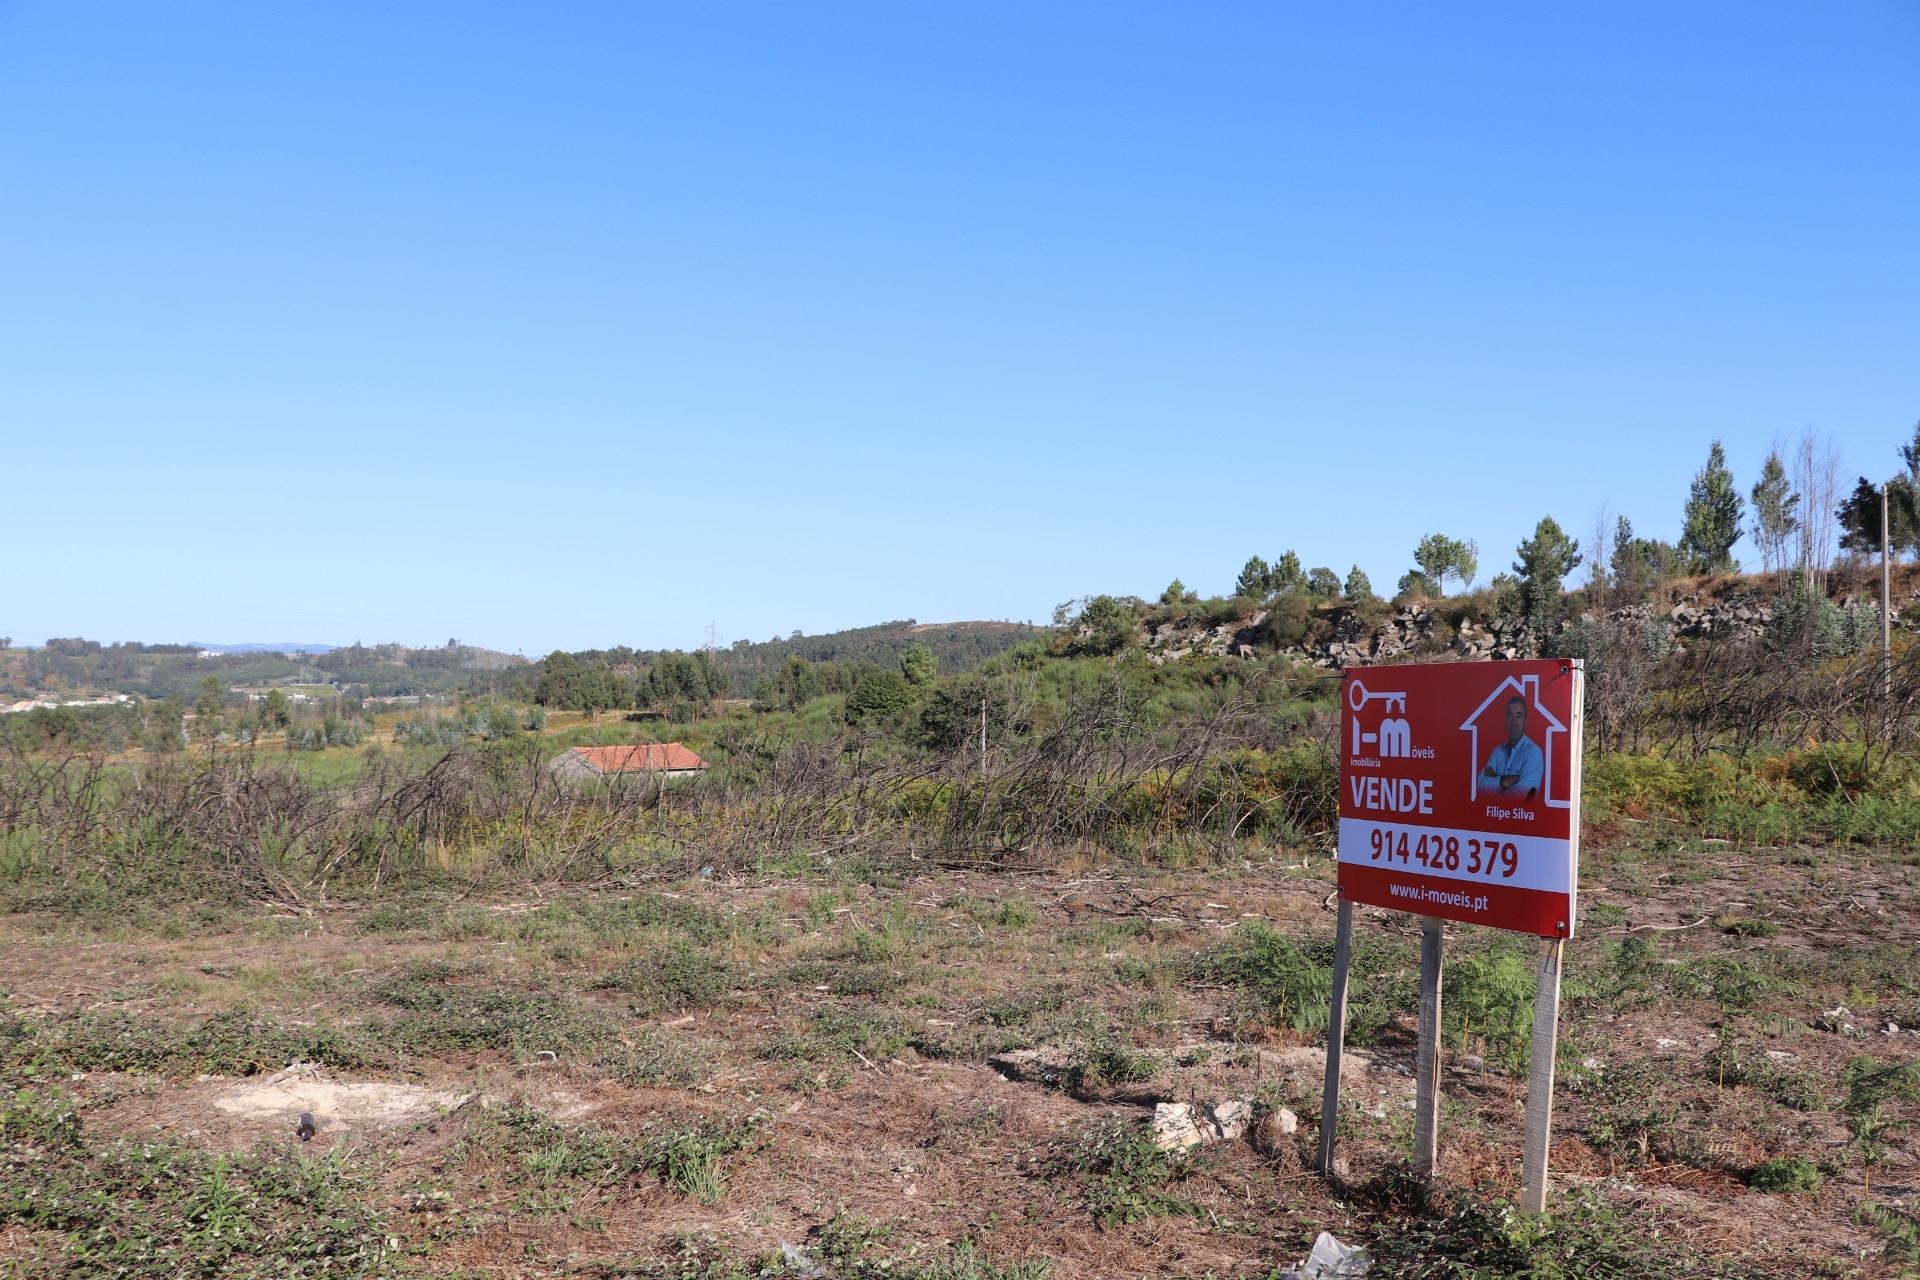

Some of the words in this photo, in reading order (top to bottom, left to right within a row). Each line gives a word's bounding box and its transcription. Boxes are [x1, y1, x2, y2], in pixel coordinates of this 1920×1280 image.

[1350, 775, 1433, 815] VENDE
[1486, 806, 1511, 820] Filipe
[1512, 808, 1535, 821] Silva
[1371, 828, 1410, 864] 914
[1415, 834, 1460, 871] 428
[1467, 839, 1518, 878] 379
[1390, 882, 1489, 912] www.i-moveis.pt
